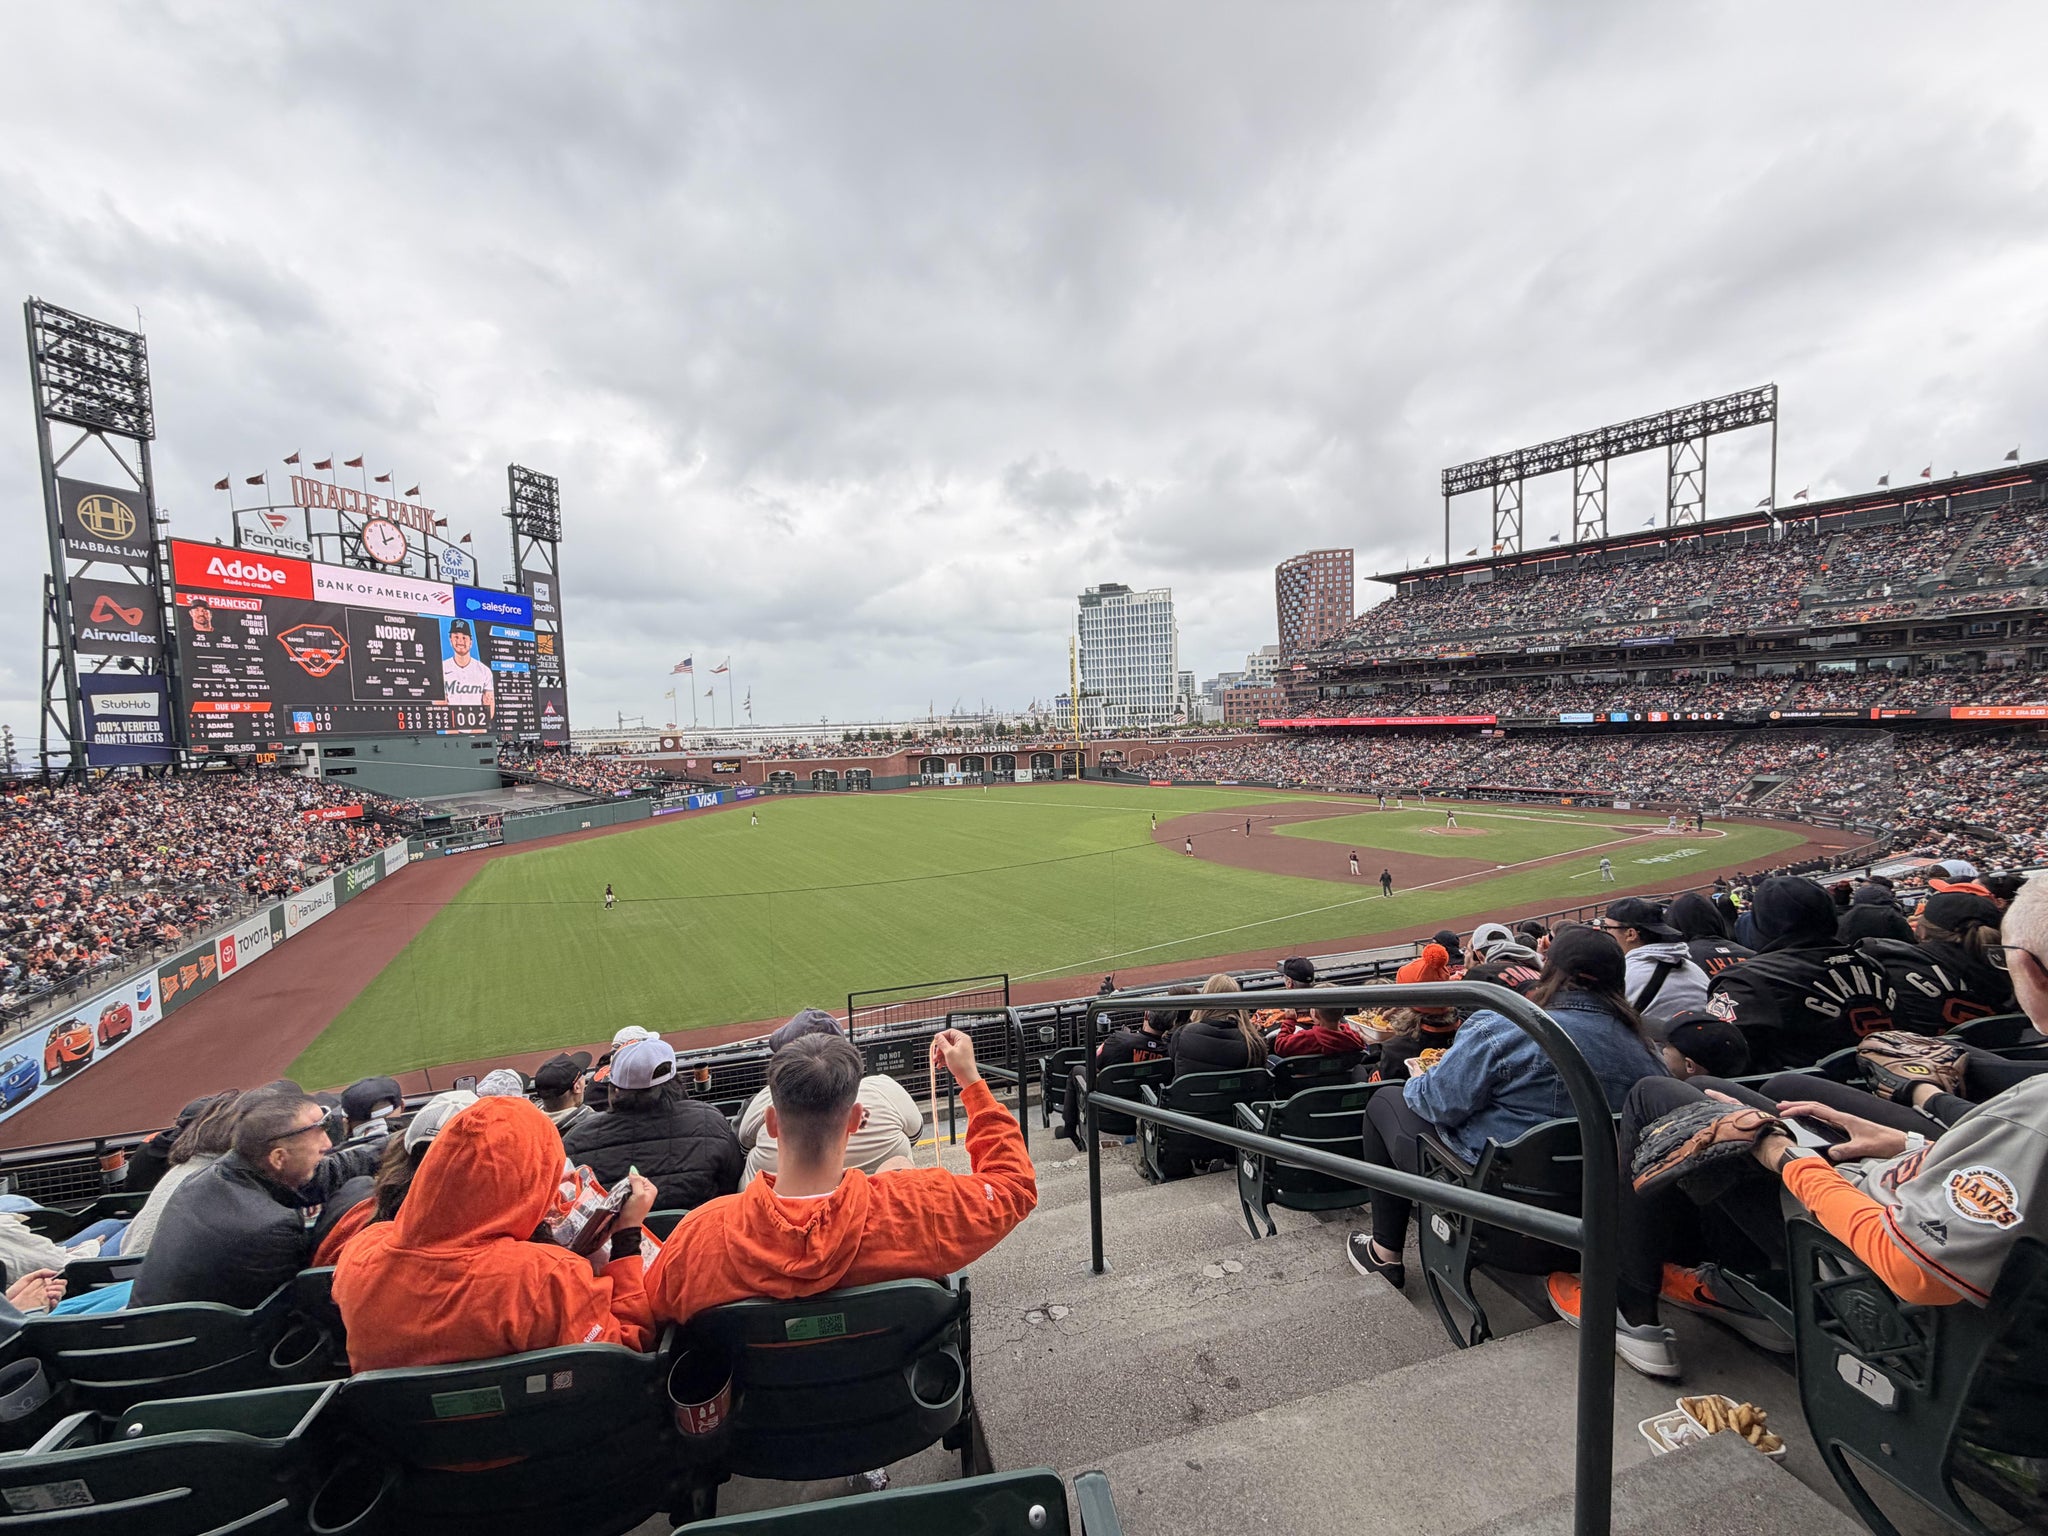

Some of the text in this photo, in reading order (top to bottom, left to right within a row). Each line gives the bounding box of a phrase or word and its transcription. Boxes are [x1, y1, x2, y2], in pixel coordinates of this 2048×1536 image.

[289, 475, 438, 537] ORACLE PARK
[244, 528, 311, 552] Fanatics
[70, 539, 148, 558] HABBAS LAW
[207, 557, 286, 584] Adobe
[441, 565, 470, 579] coupa
[318, 579, 429, 602] BANK OF AMERICA
[208, 598, 258, 610] FRANCISCO
[482, 602, 522, 615] salesforce
[240, 619, 264, 627] ROBBIE
[384, 615, 405, 624] CONNOR
[81, 628, 156, 644] Airwallex
[249, 628, 264, 636] RAY
[376, 625, 415, 641] NORBY
[367, 640, 423, 652] .244 3 10
[101, 700, 150, 710] StubHub
[316, 713, 321, 721] 0
[325, 713, 330, 721] 0
[398, 712, 404, 720] 0
[457, 713, 486, 726] 0 0 2
[541, 714, 564, 722] enjamin
[96, 720, 160, 732] 100% VERIFIED
[317, 723, 322, 731] 0
[325, 723, 331, 731] 0
[399, 721, 405, 729] 0
[95, 732, 164, 744] GIANTS TICKETS
[224, 744, 256, 753] $25,950
[967, 745, 1018, 753] LANDING
[256, 753, 276, 763] 0:09
[696, 793, 718, 807] VISA
[410, 852, 424, 860] 399
[238, 926, 269, 954] TOYOTA
[272, 932, 283, 943] 354
[1906, 965, 1967, 998] GI
[1804, 965, 1896, 1018] GIANTS
[889, 1051, 900, 1059] NOT
[1983, 1172, 2013, 1204] FRANCISCO
[1950, 1174, 2016, 1226] GIANTS
[1437, 1219, 1444, 1235] E
[1856, 1364, 1876, 1387] F
